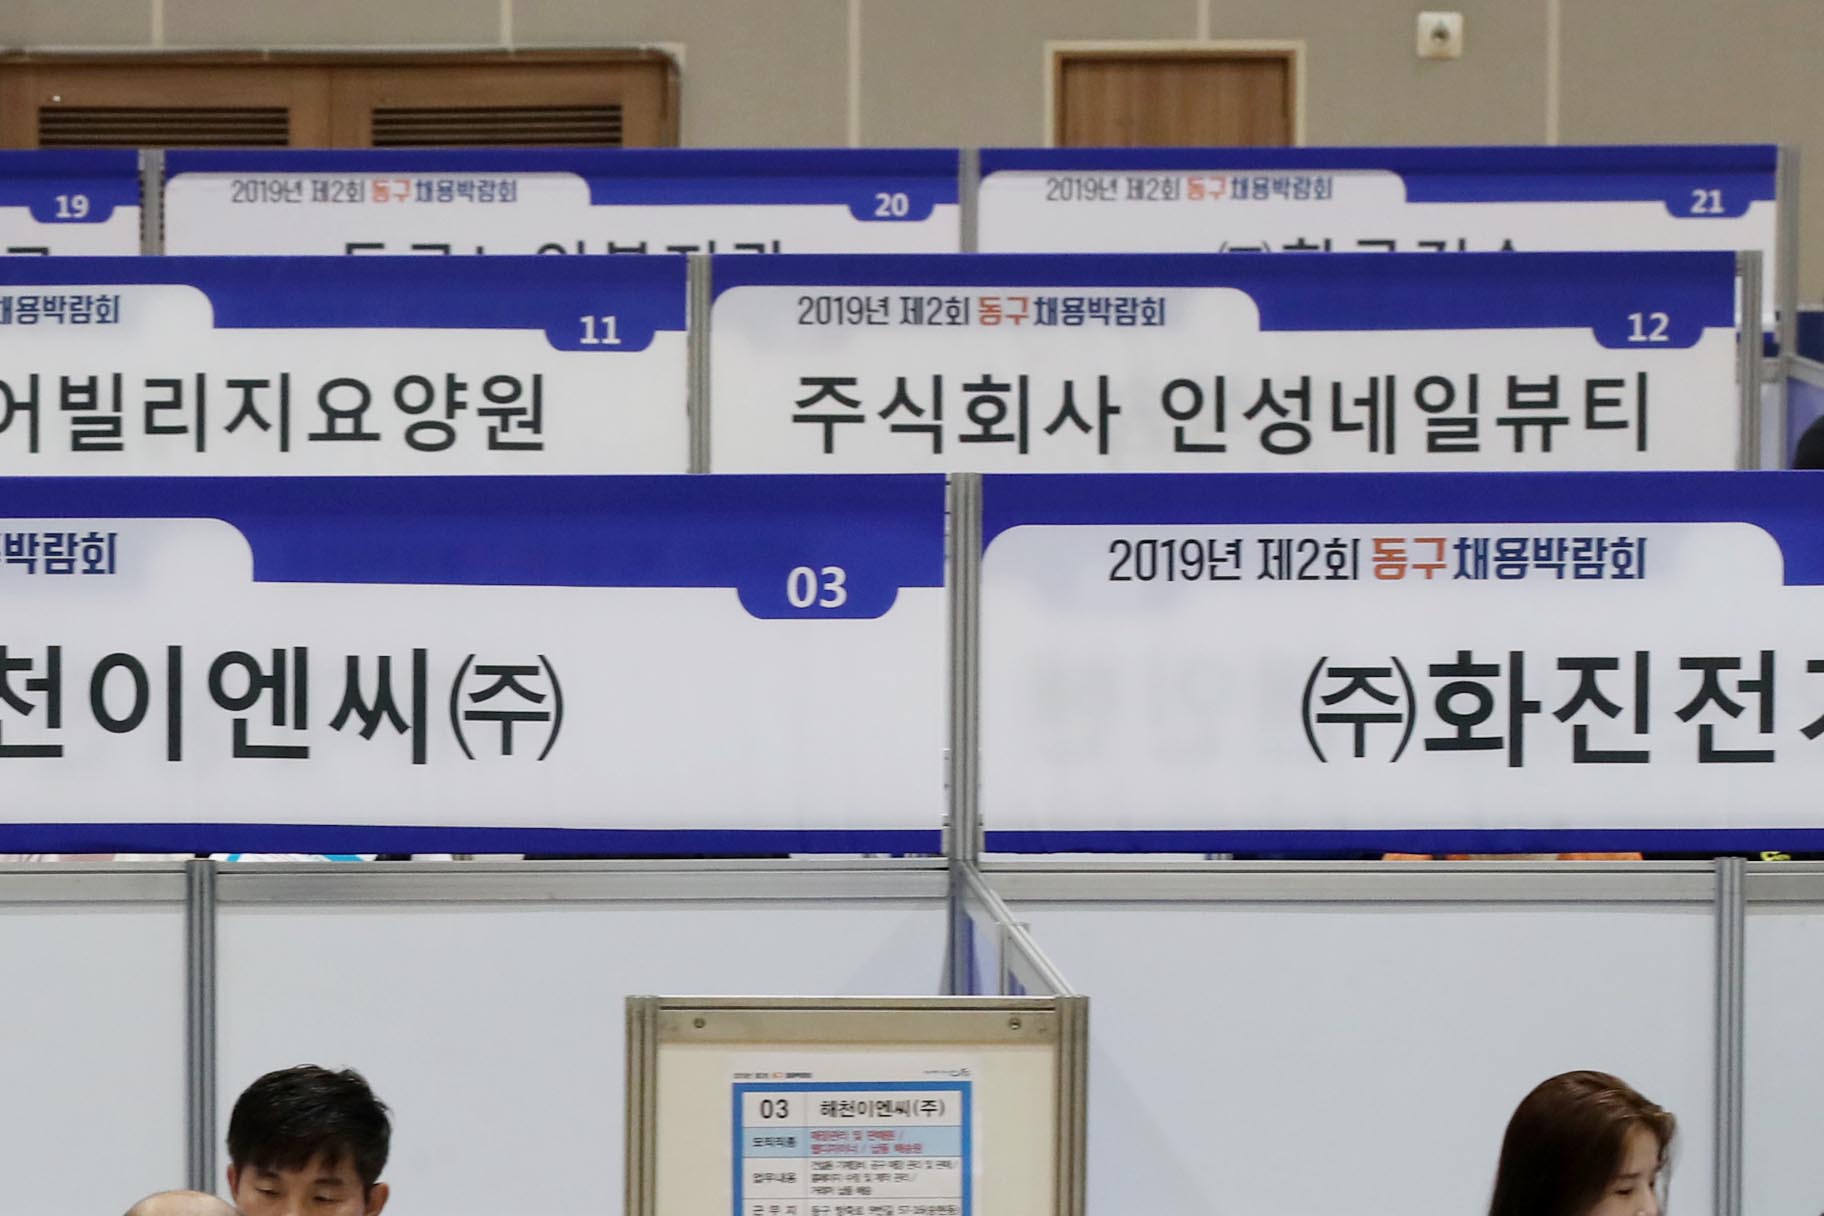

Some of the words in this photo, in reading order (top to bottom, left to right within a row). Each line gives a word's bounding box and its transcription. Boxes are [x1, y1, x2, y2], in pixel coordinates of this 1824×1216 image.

[231, 179, 303, 203] 2019년
[312, 179, 365, 203] 제2회
[1045, 178, 1117, 201] 2019년
[1127, 177, 1180, 201] 제2회
[1690, 189, 1724, 214] 21
[55, 195, 89, 218] 19
[874, 193, 908, 217] 20
[798, 296, 890, 326] 2019년
[900, 296, 970, 326] 제2회
[579, 315, 621, 344] 11
[1627, 312, 1669, 342] 12
[792, 374, 1120, 455] 주식회사
[1161, 372, 1647, 455] 인성네일뷰티
[1108, 539, 1243, 582] 2019년
[1257, 537, 1359, 581] 제2회
[787, 566, 847, 608] 03
[1302, 650, 1824, 767] (주)화진전
[759, 1099, 789, 1120] 03
[819, 1099, 946, 1119] 해천이엔씨(주)
